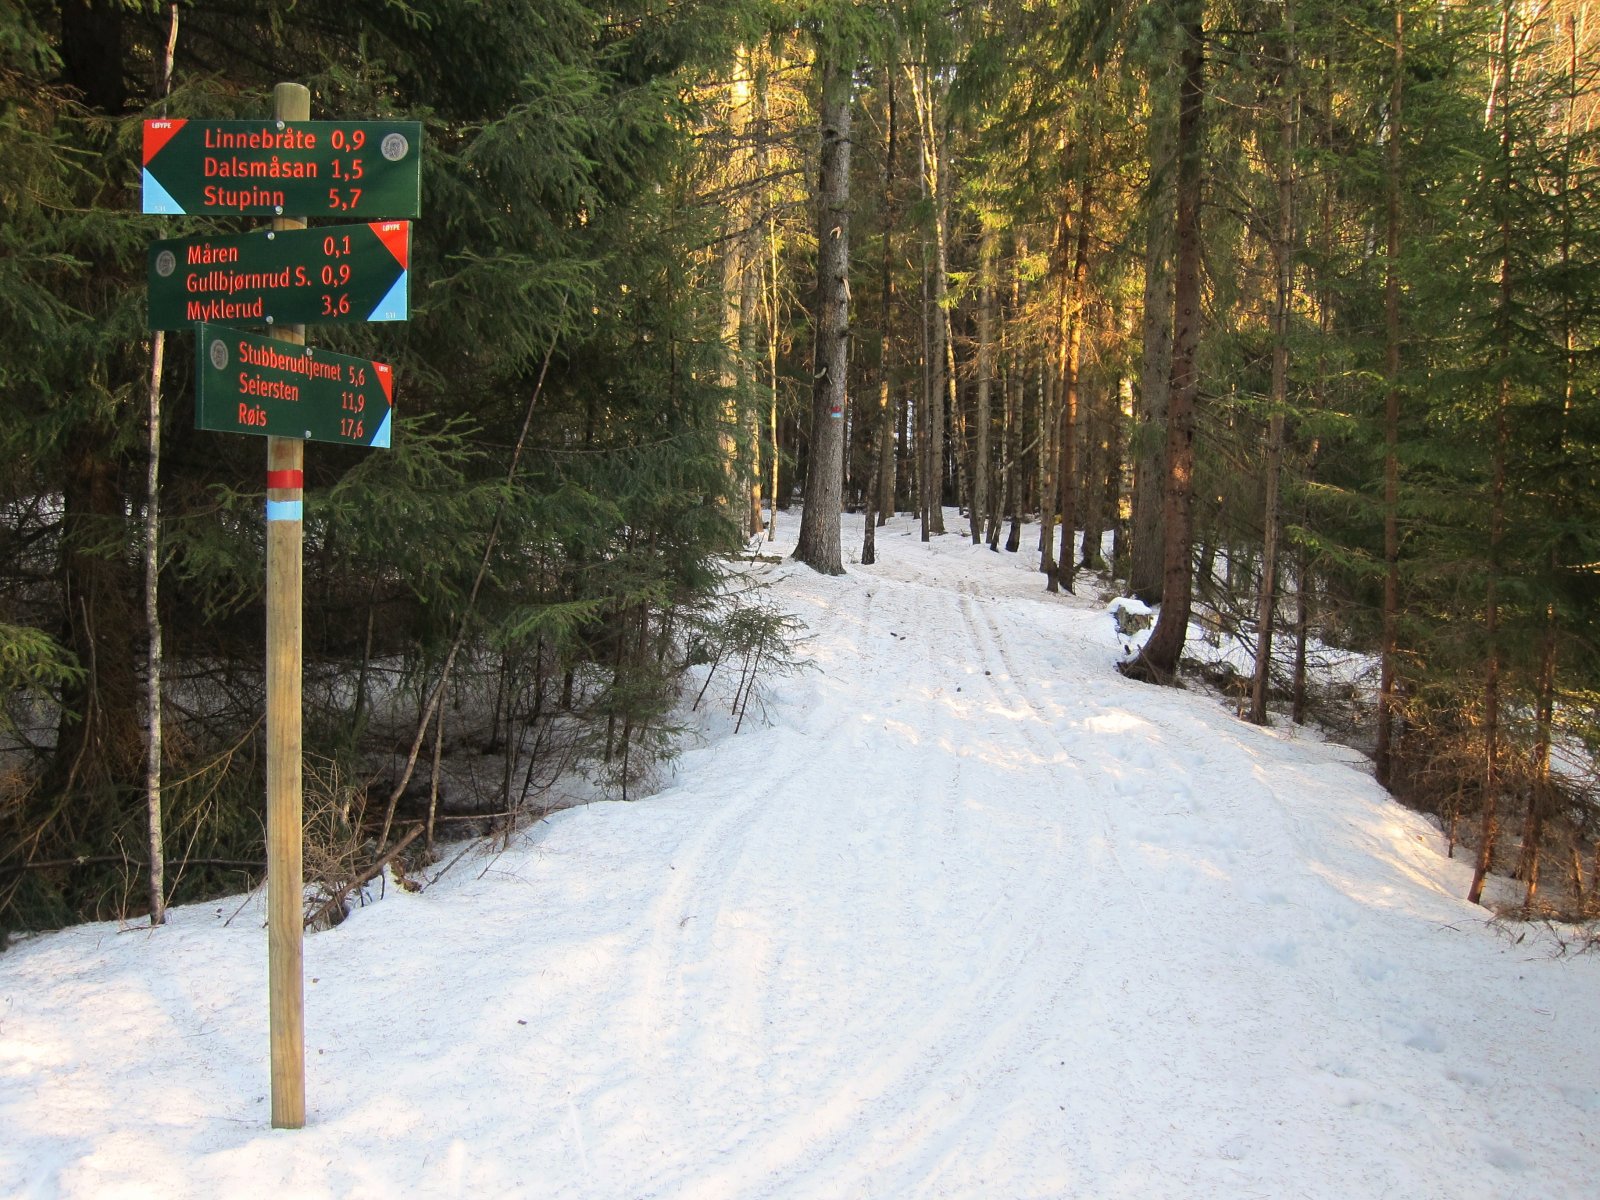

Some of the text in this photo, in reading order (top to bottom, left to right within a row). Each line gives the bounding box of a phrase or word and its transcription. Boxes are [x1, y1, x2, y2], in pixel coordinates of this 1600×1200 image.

[204, 128, 317, 150] Linnebråte
[331, 129, 366, 152] 0,9
[204, 156, 364, 181] Dalsmåsan 1,5
[203, 186, 363, 211] Stupinn 5,7
[187, 243, 238, 265] Måren
[323, 236, 351, 258] 0,1
[187, 265, 351, 295] Gullbjørnrud S. 0,9
[187, 294, 351, 323] Myklerud 3,6
[239, 341, 342, 381] Stubberudtjernet
[349, 367, 366, 386] 5,6
[239, 372, 365, 413] Seiersten 11,9
[238, 403, 364, 439] Røis 17,6
